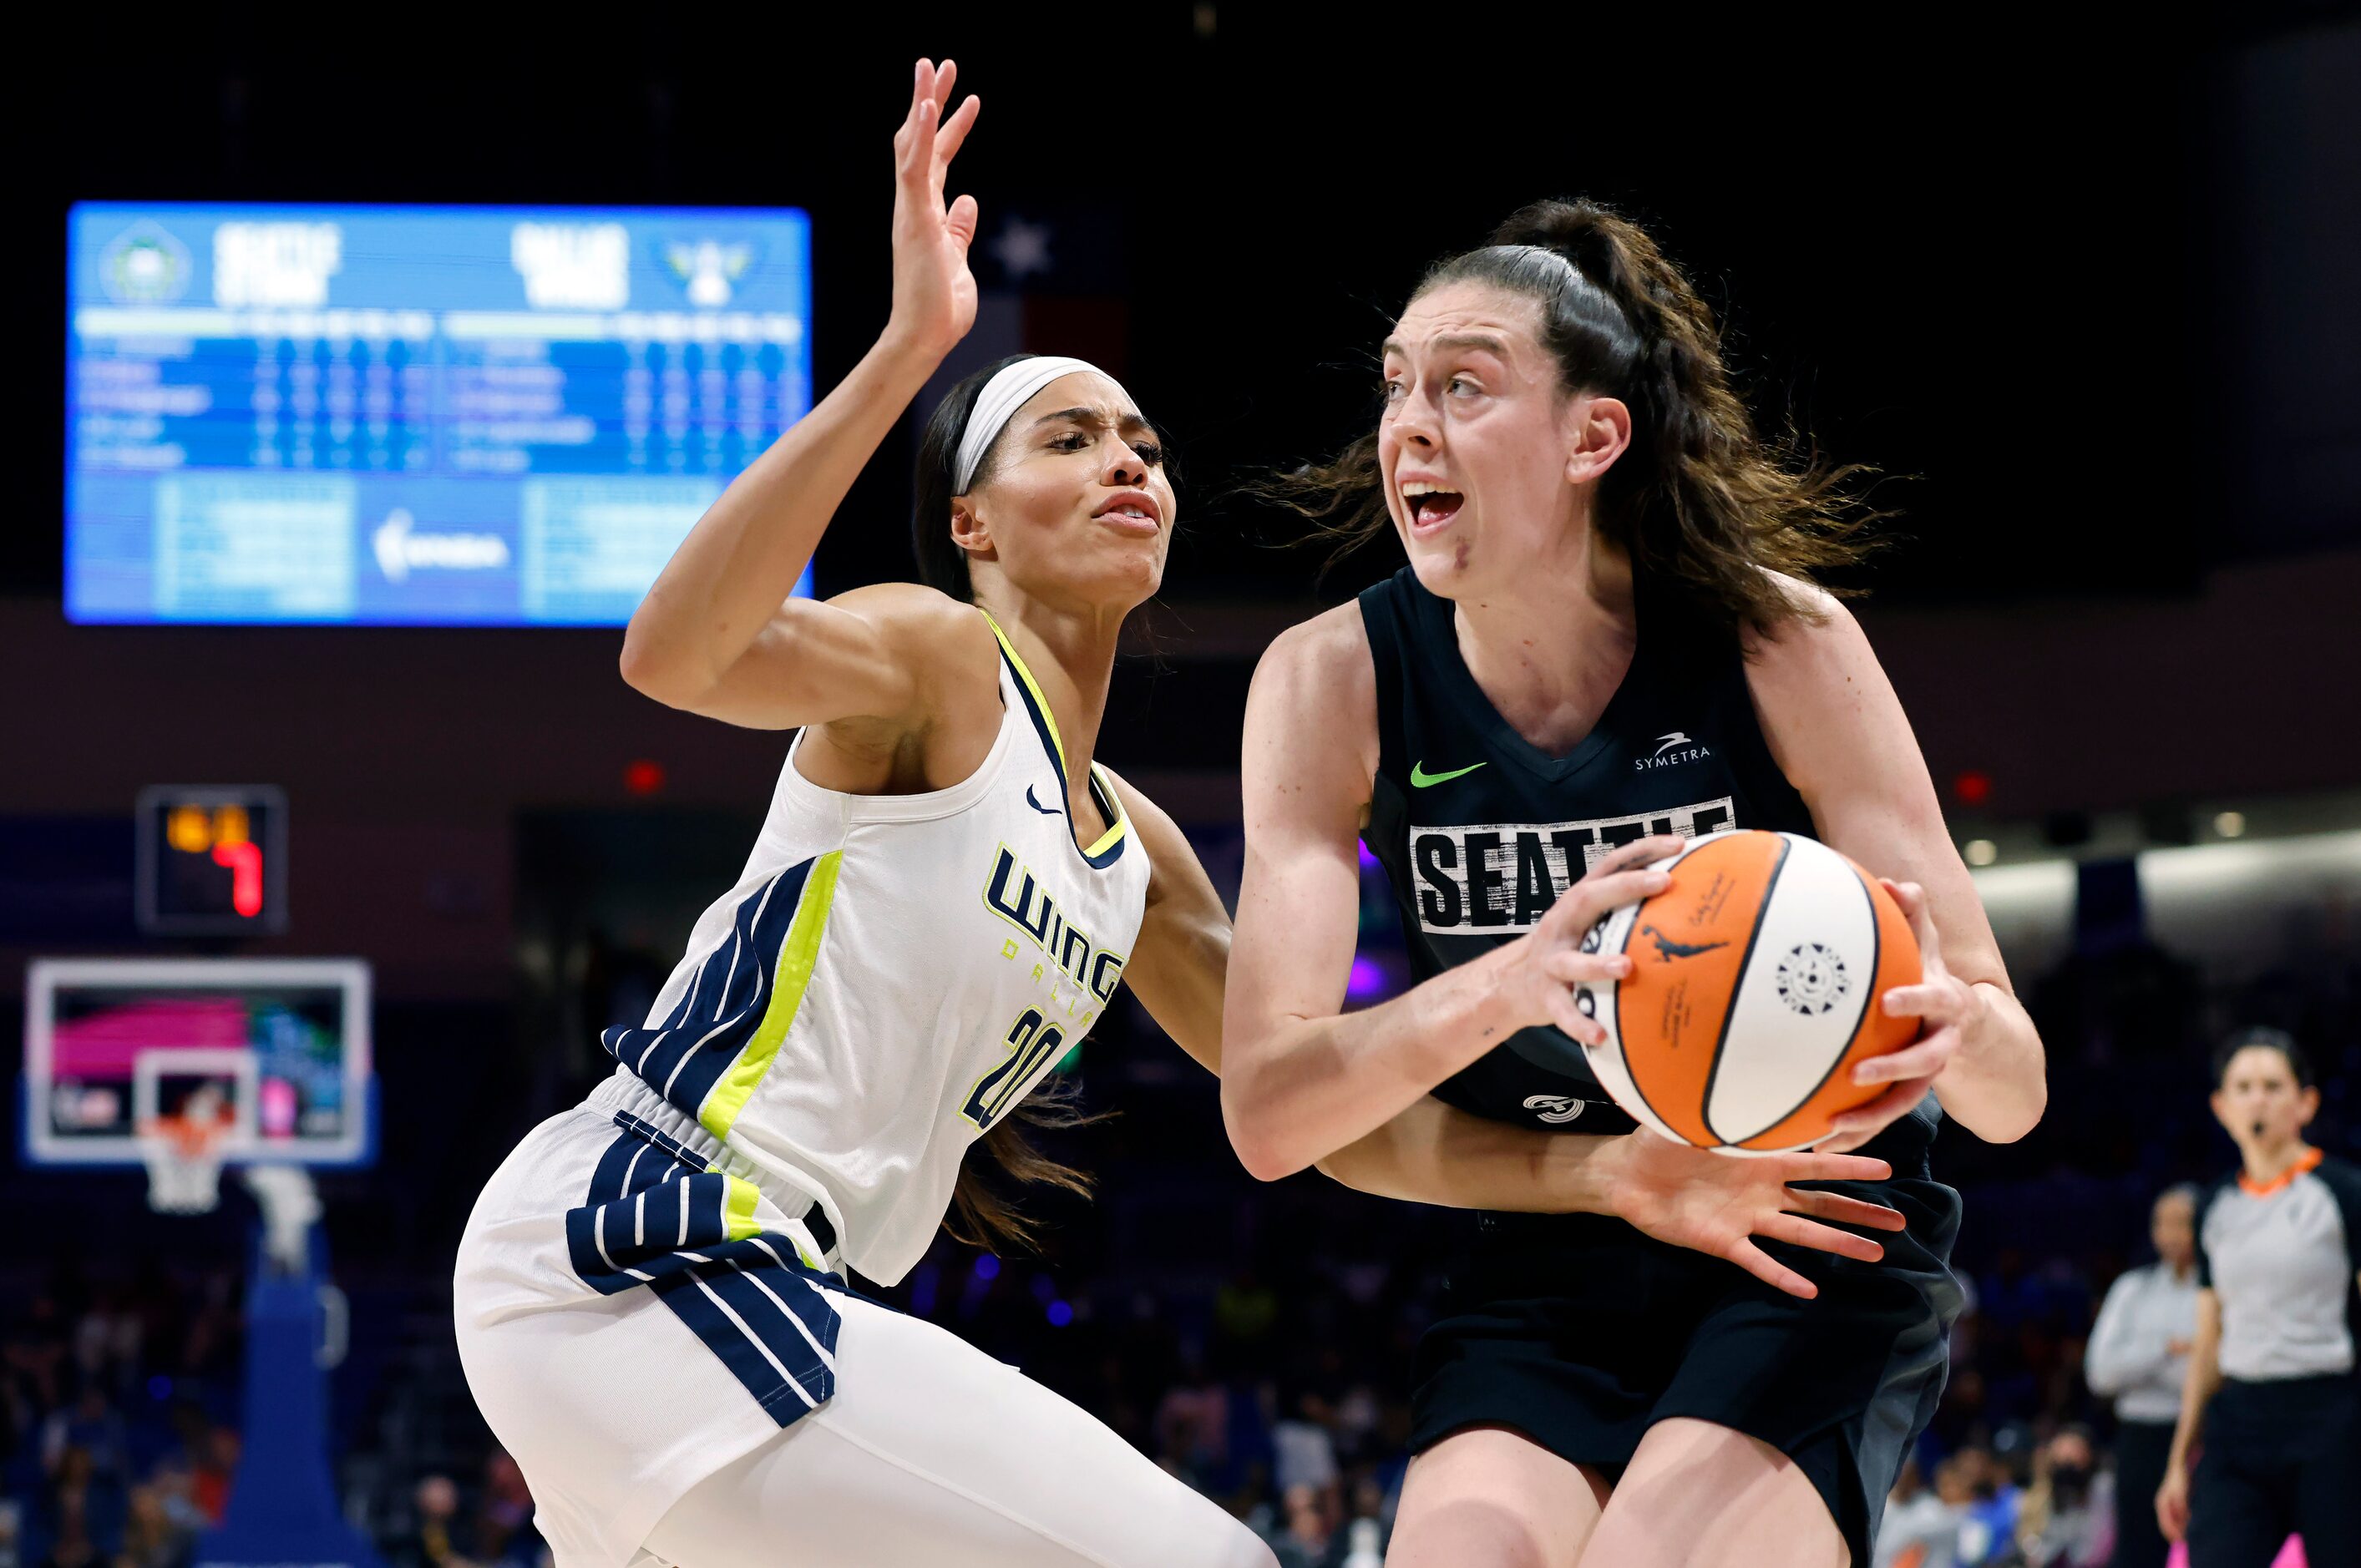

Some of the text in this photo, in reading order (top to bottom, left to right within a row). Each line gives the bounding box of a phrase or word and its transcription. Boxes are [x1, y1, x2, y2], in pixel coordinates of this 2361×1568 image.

[1634, 746, 1711, 771] SYMETRA
[1413, 806, 1729, 928] SEAT
[956, 1005, 1067, 1132] 20
